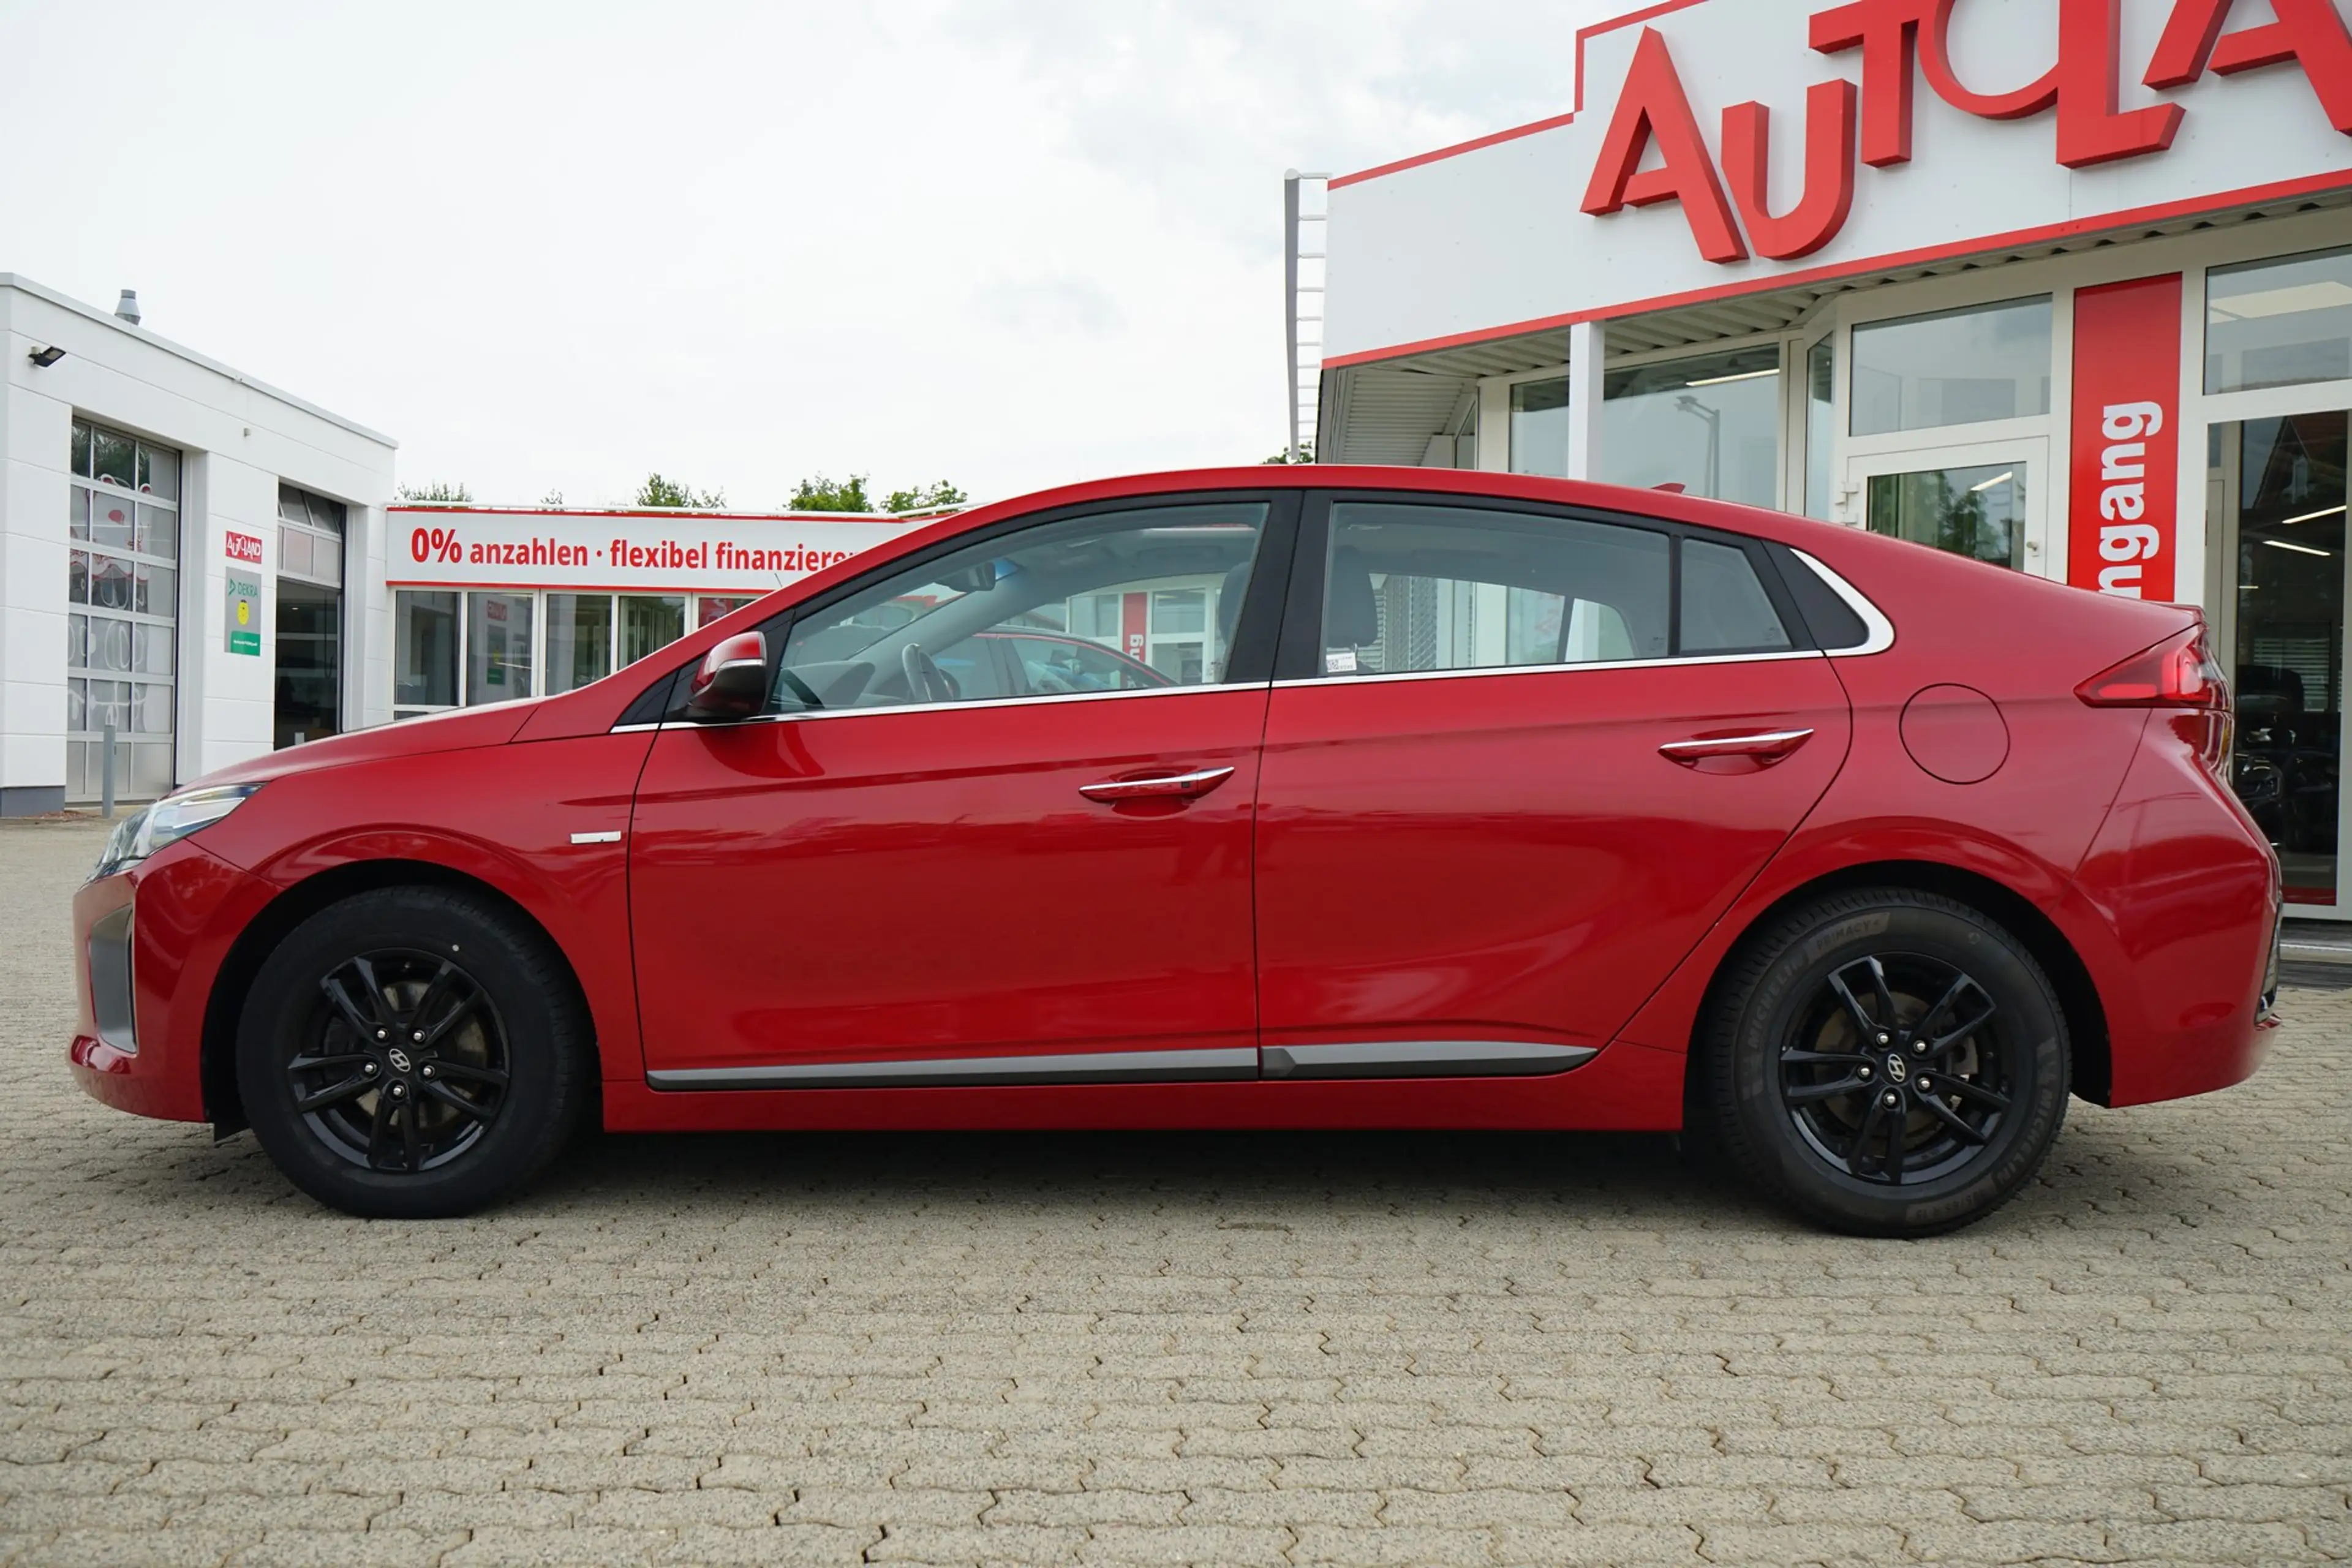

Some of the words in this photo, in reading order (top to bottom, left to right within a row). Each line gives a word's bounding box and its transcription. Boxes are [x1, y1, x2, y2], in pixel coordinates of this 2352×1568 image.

[411, 527, 462, 563] 0%
[470, 538, 588, 566] anzahlen
[610, 539, 708, 569] flexibel
[715, 542, 858, 572] finanzier
[238, 581, 258, 598] DEKRA
[1816, 919, 1871, 951] PRIMACY
[1747, 948, 1811, 1050] MICHELIN
[1997, 1088, 2053, 1185] MICHELIN
